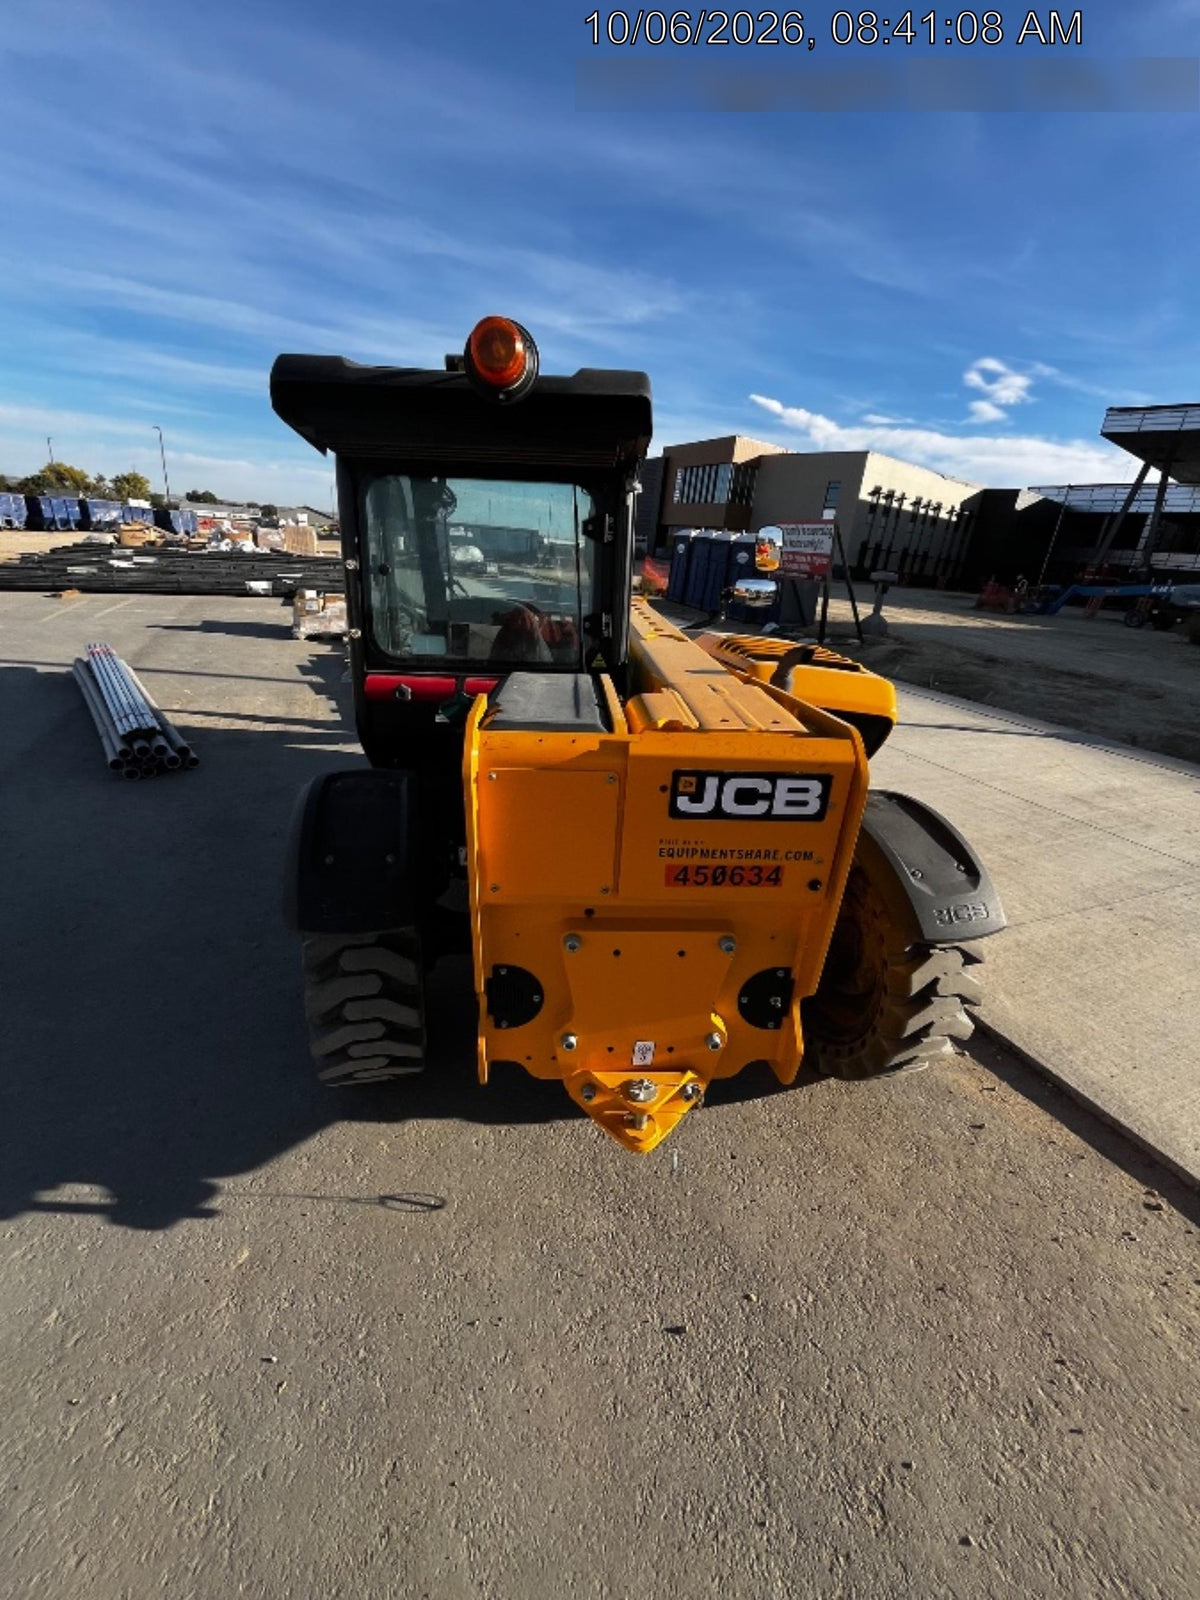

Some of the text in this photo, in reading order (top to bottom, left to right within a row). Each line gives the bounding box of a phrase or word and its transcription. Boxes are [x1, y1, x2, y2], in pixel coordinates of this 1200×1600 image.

[676, 776, 823, 815] JCB
[658, 847, 814, 861] EQUIPMENTSHARE.COM
[673, 866, 783, 886] 450634
